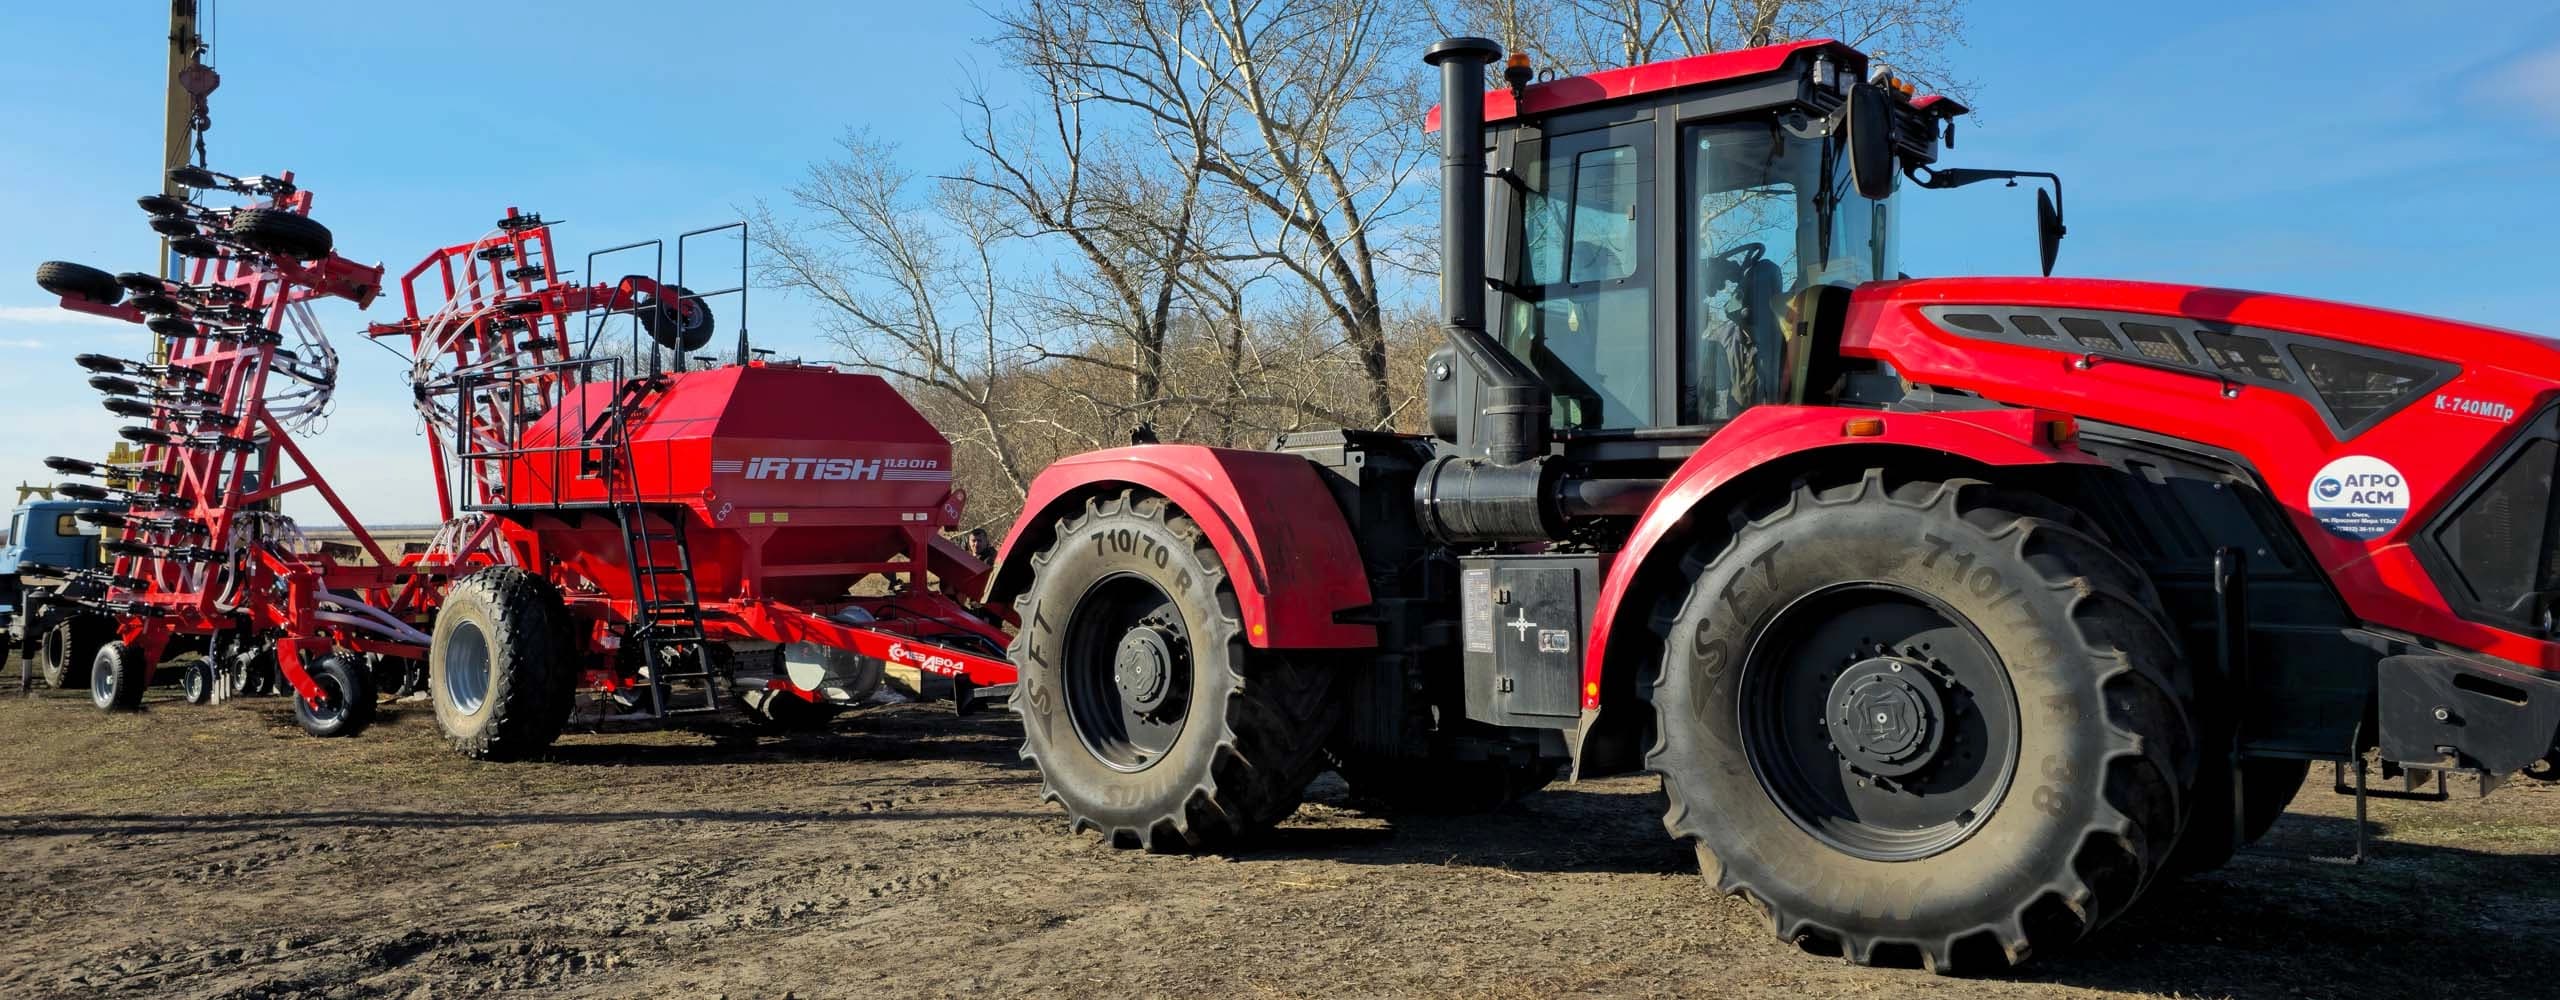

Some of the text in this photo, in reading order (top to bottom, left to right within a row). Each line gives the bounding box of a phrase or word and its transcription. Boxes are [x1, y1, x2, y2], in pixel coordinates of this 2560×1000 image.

[2434, 394, 2514, 422] К-740МПр
[2345, 474, 2400, 488] АГРО
[2351, 491, 2394, 504] АСМ
[1091, 529, 1169, 570] 710/70
